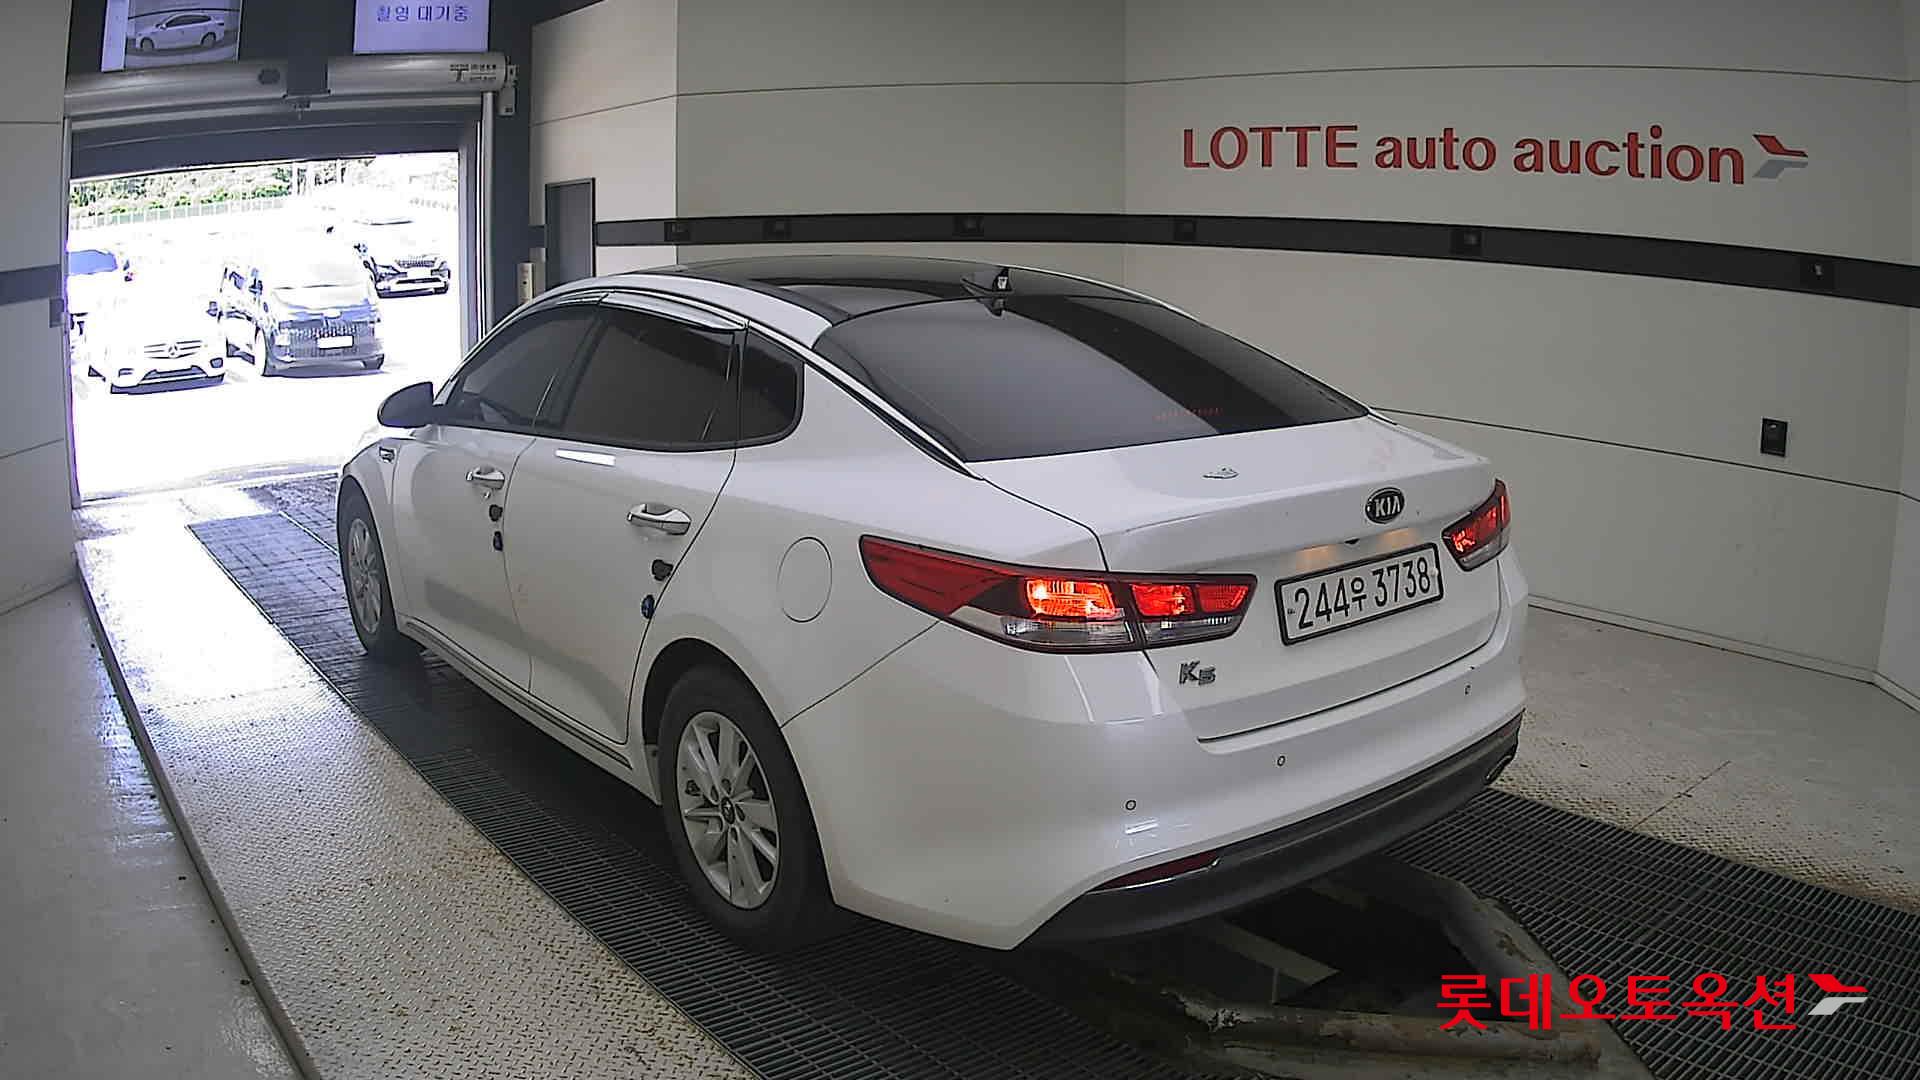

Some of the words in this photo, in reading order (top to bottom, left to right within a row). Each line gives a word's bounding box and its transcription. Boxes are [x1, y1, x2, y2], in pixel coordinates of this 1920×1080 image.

[417, 5, 469, 22] 대기중
[1183, 125, 1358, 169] LOTTE
[1374, 127, 1497, 171] auto
[1512, 124, 1745, 185] auction
[1374, 495, 1401, 517] KIA
[1294, 576, 1367, 629] 244우
[1372, 557, 1431, 607] 3738
[1178, 660, 1216, 685] K5
